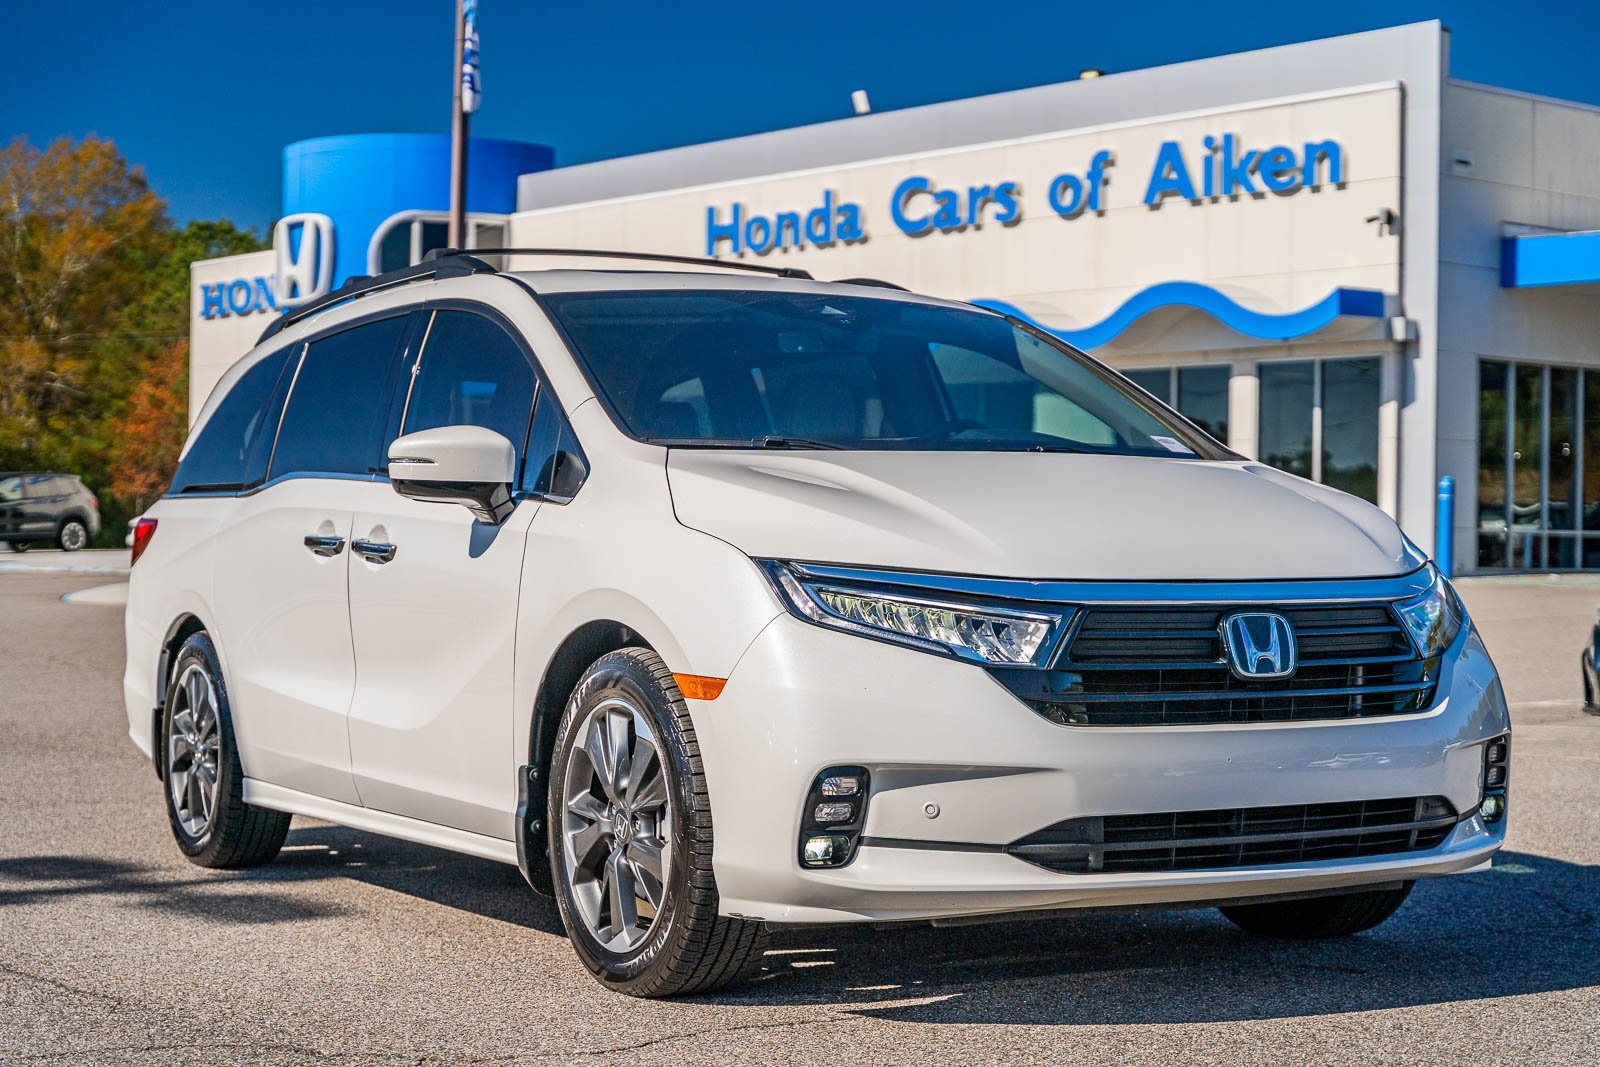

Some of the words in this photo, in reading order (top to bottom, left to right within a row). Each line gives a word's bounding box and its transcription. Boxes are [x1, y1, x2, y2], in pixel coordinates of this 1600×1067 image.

[706, 189, 863, 256] Honda
[891, 176, 1018, 234] Cars
[1048, 150, 1110, 216] of
[1143, 133, 1341, 205] Aiken
[200, 274, 277, 318] HON
